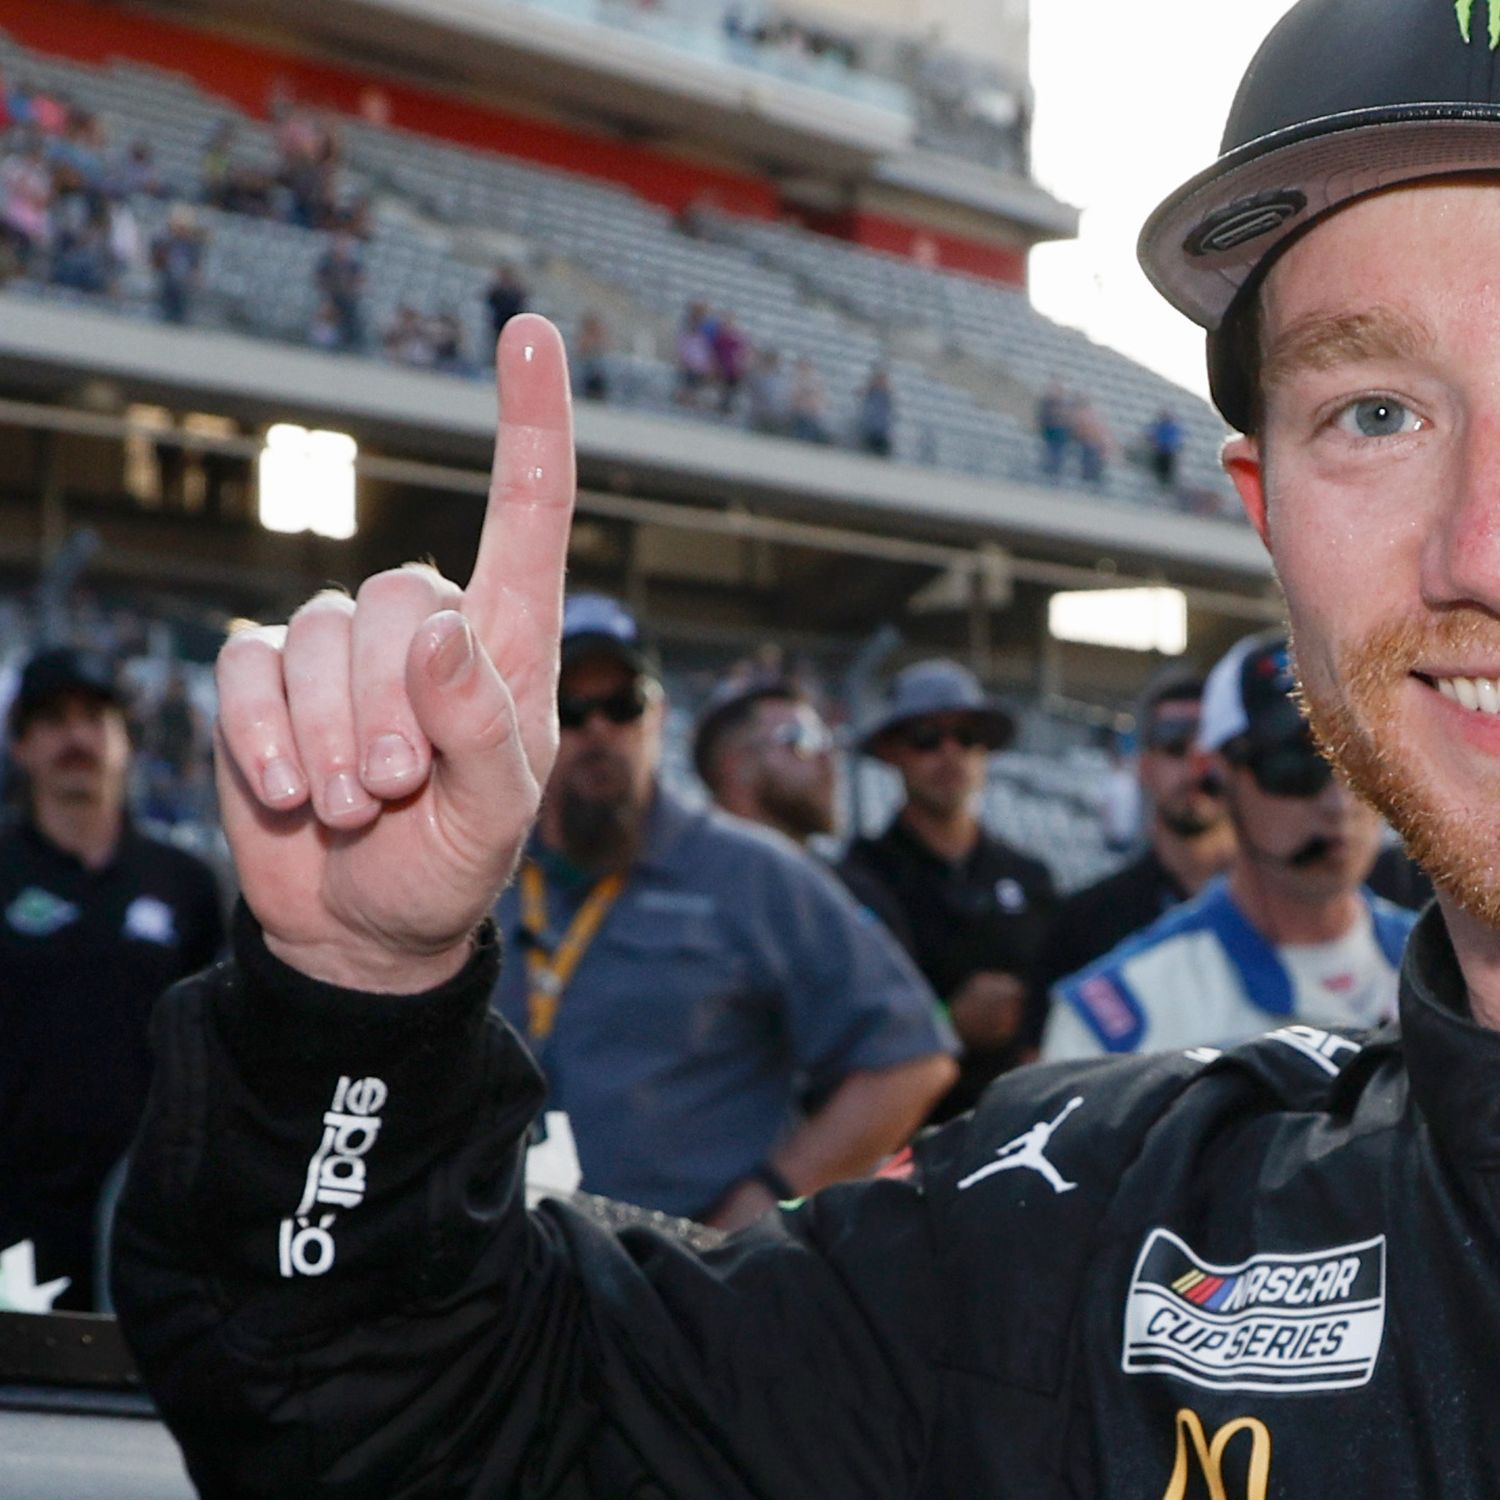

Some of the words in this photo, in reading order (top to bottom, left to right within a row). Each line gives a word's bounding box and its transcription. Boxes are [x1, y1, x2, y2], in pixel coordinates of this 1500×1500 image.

[279, 1075, 389, 1278] sparo
[1220, 1257, 1361, 1312] NASCAR
[1146, 1307, 1228, 1352] CUP
[1224, 1320, 1350, 1361] SERIES
